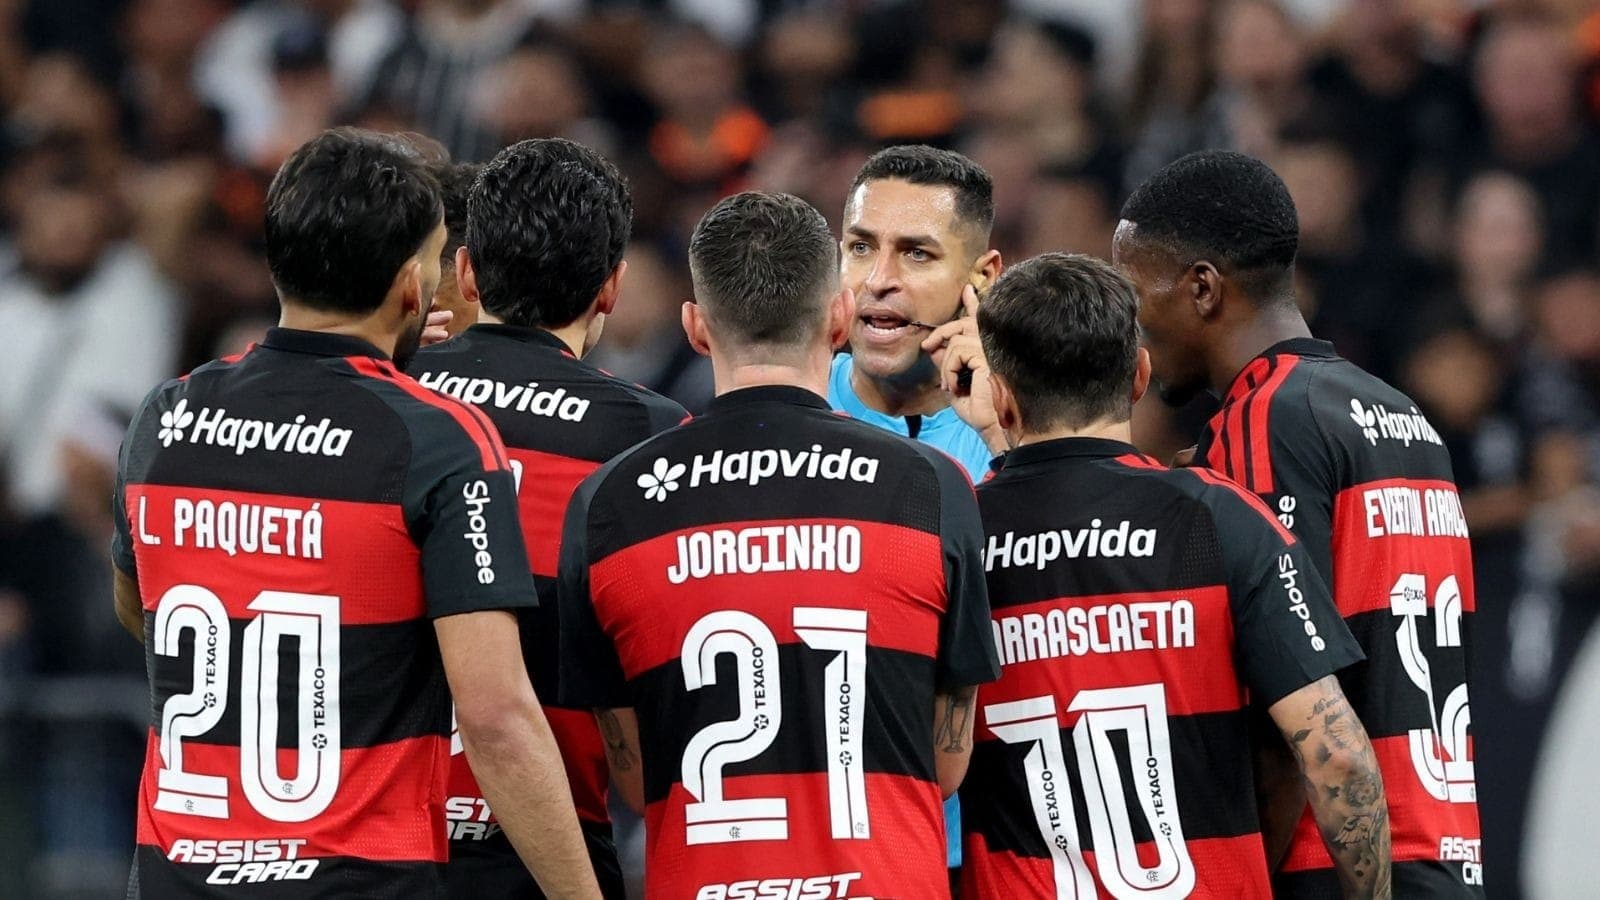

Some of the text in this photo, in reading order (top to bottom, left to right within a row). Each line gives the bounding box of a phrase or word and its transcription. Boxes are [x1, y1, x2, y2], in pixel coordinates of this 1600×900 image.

[189, 408, 353, 456] Hapvida
[689, 444, 879, 488] Hapvida
[139, 496, 323, 559] L. PAQUETÁ
[463, 480, 495, 585] Shopee
[667, 524, 862, 584] JORGINHO
[985, 518, 1157, 572] Hapvida
[1279, 553, 1326, 652] Shopee
[206, 624, 218, 687] TEXACO
[753, 646, 767, 710] TEXACO
[153, 584, 341, 822] 20
[314, 667, 326, 729] TEXACO
[681, 606, 871, 846] 21
[839, 683, 852, 745] TEXACO
[984, 682, 1197, 900] 10
[1041, 770, 1060, 831] TEXACO
[1146, 757, 1166, 818] TEXACO
[167, 839, 307, 864] ASSIST
[206, 859, 320, 885] CARD
[695, 872, 861, 900] ASSIST
